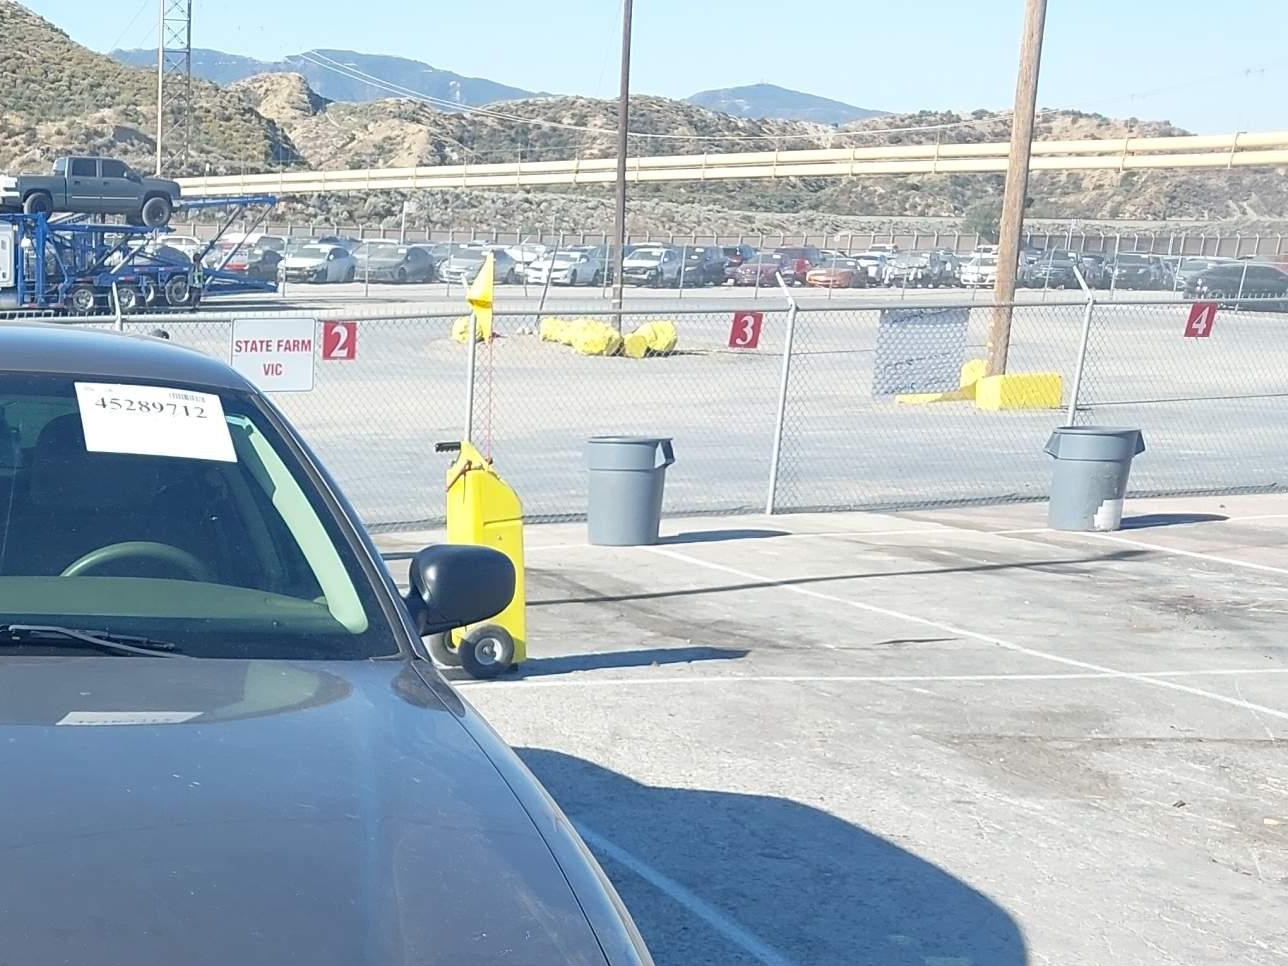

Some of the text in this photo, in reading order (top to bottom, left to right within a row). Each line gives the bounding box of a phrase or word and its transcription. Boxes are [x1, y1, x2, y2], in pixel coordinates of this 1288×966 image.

[735, 315, 755, 345] 3
[1191, 306, 1210, 334] 4
[234, 339, 312, 353] STATE FARM
[330, 324, 349, 358] 2
[263, 363, 283, 376] VIC
[94, 396, 208, 419] 45289712
